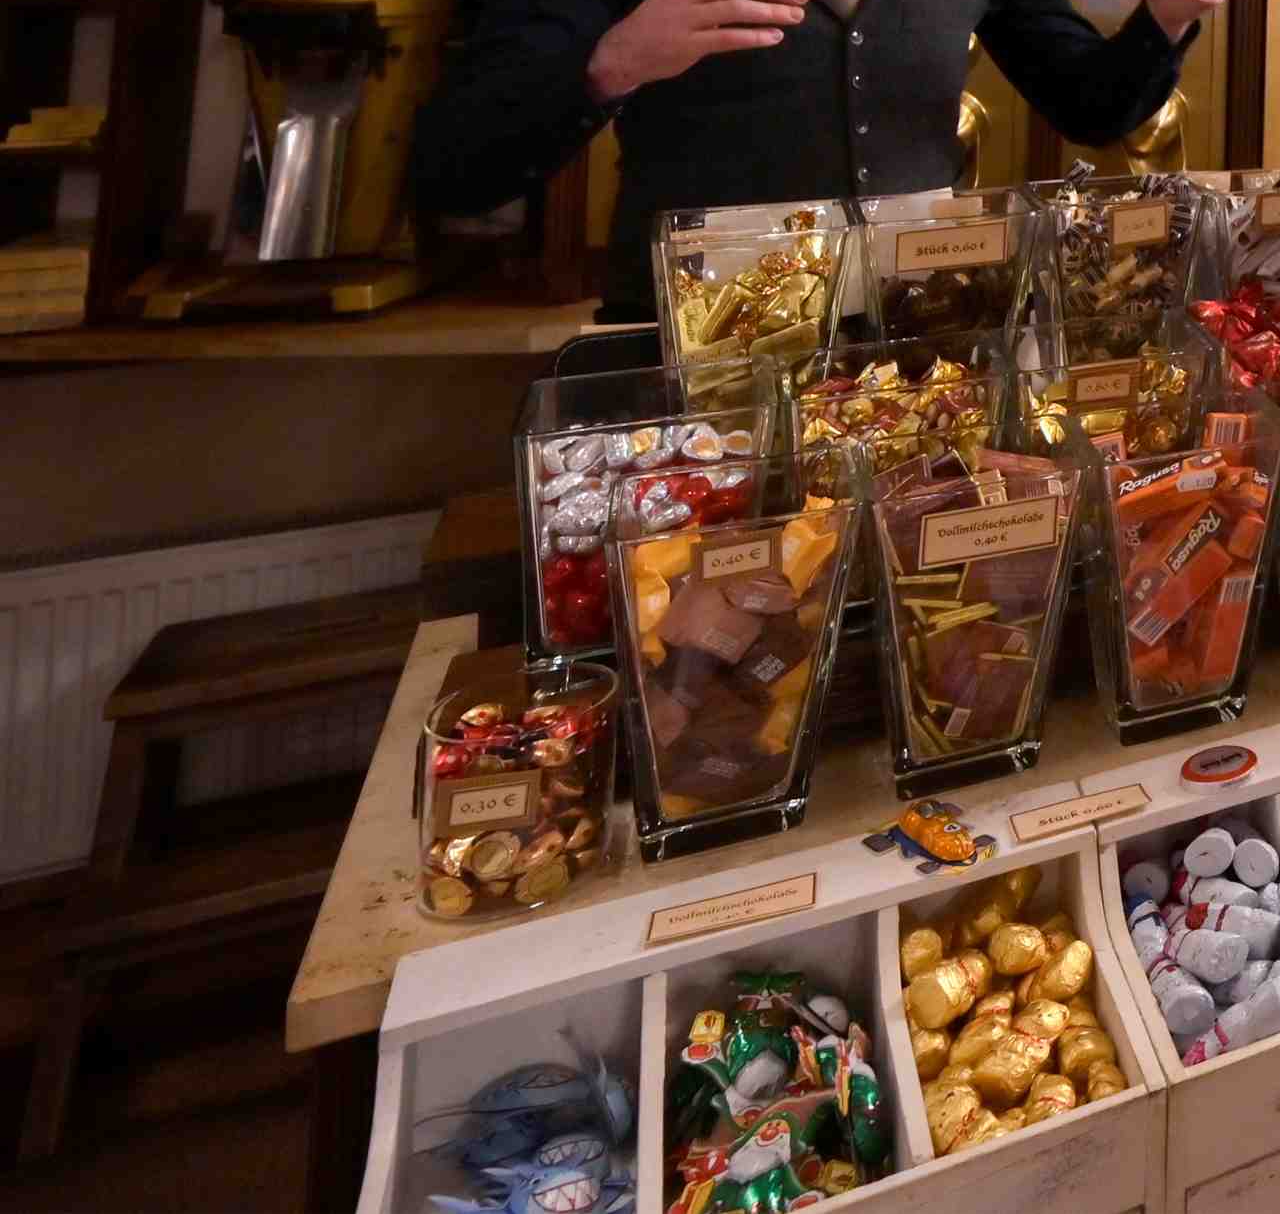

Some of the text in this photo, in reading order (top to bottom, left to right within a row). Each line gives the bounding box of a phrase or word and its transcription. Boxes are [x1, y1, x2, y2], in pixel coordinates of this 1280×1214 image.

[916, 241, 949, 257] Stück
[1117, 460, 1180, 496] Ragusa
[1171, 508, 1222, 573] Ragusa
[750, 547, 761, 561] €
[503, 793, 521, 807] €
